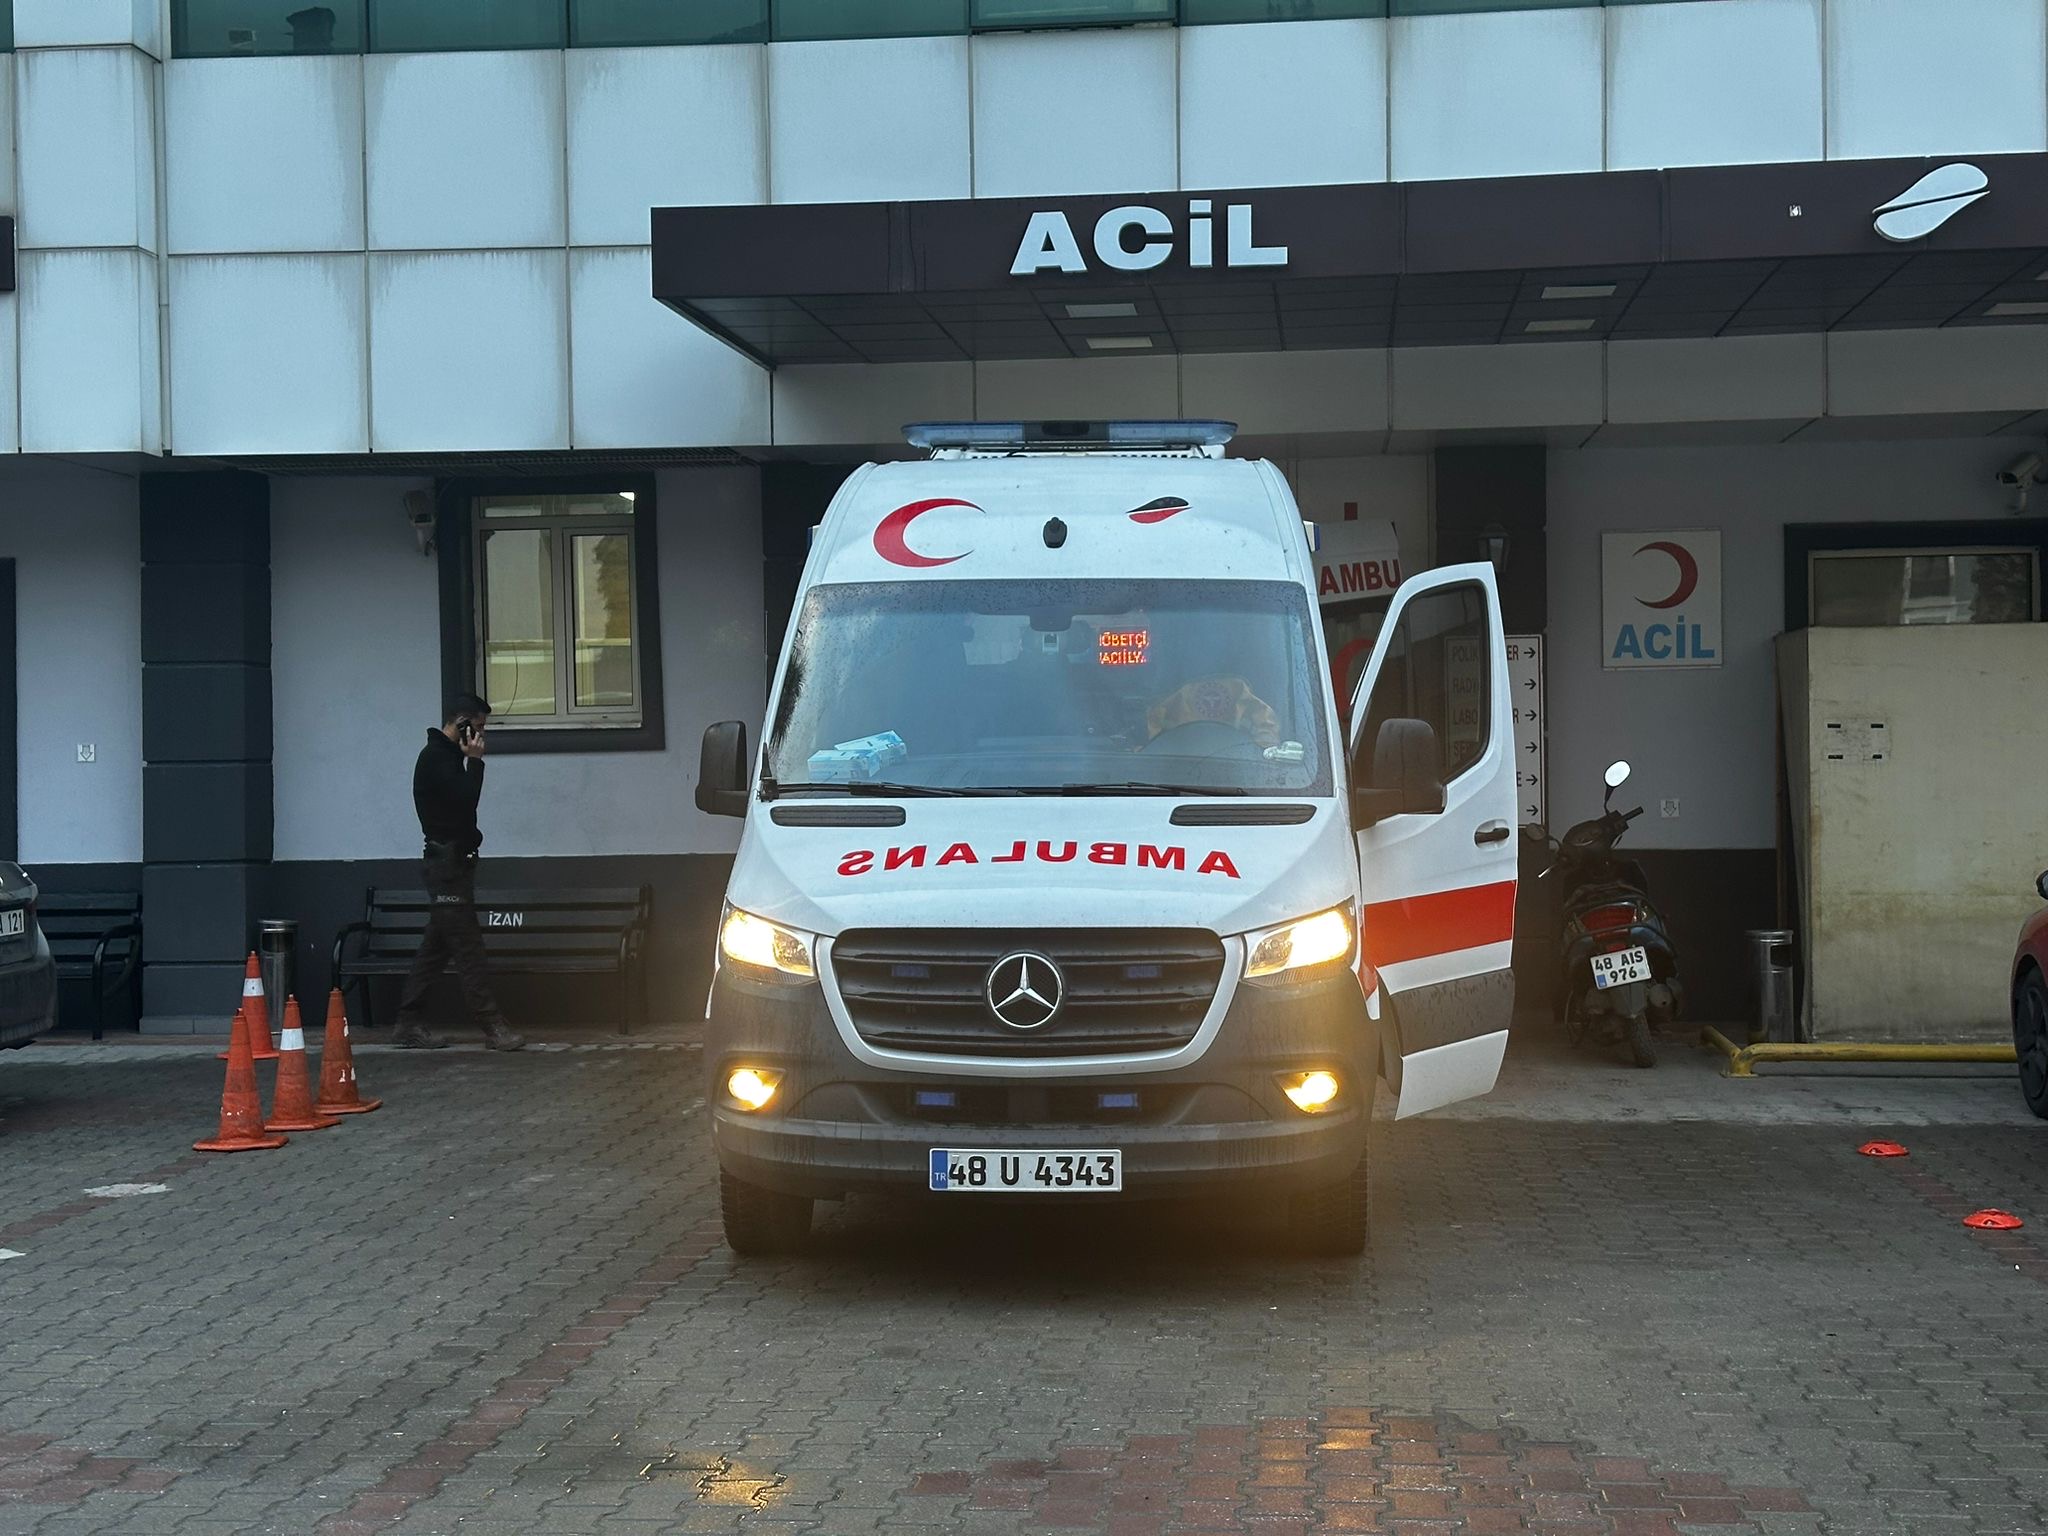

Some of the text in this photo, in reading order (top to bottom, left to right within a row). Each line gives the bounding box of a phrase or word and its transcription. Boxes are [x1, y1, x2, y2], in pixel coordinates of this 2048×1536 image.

[1010, 200, 1288, 275] ACİL
[1320, 559, 1401, 595] AMBU
[1612, 615, 1715, 659] ACİL
[1595, 951, 1643, 971] 48 AIS
[1610, 967, 1637, 982] 976
[934, 1156, 1114, 1186] TR 48 U 4343
